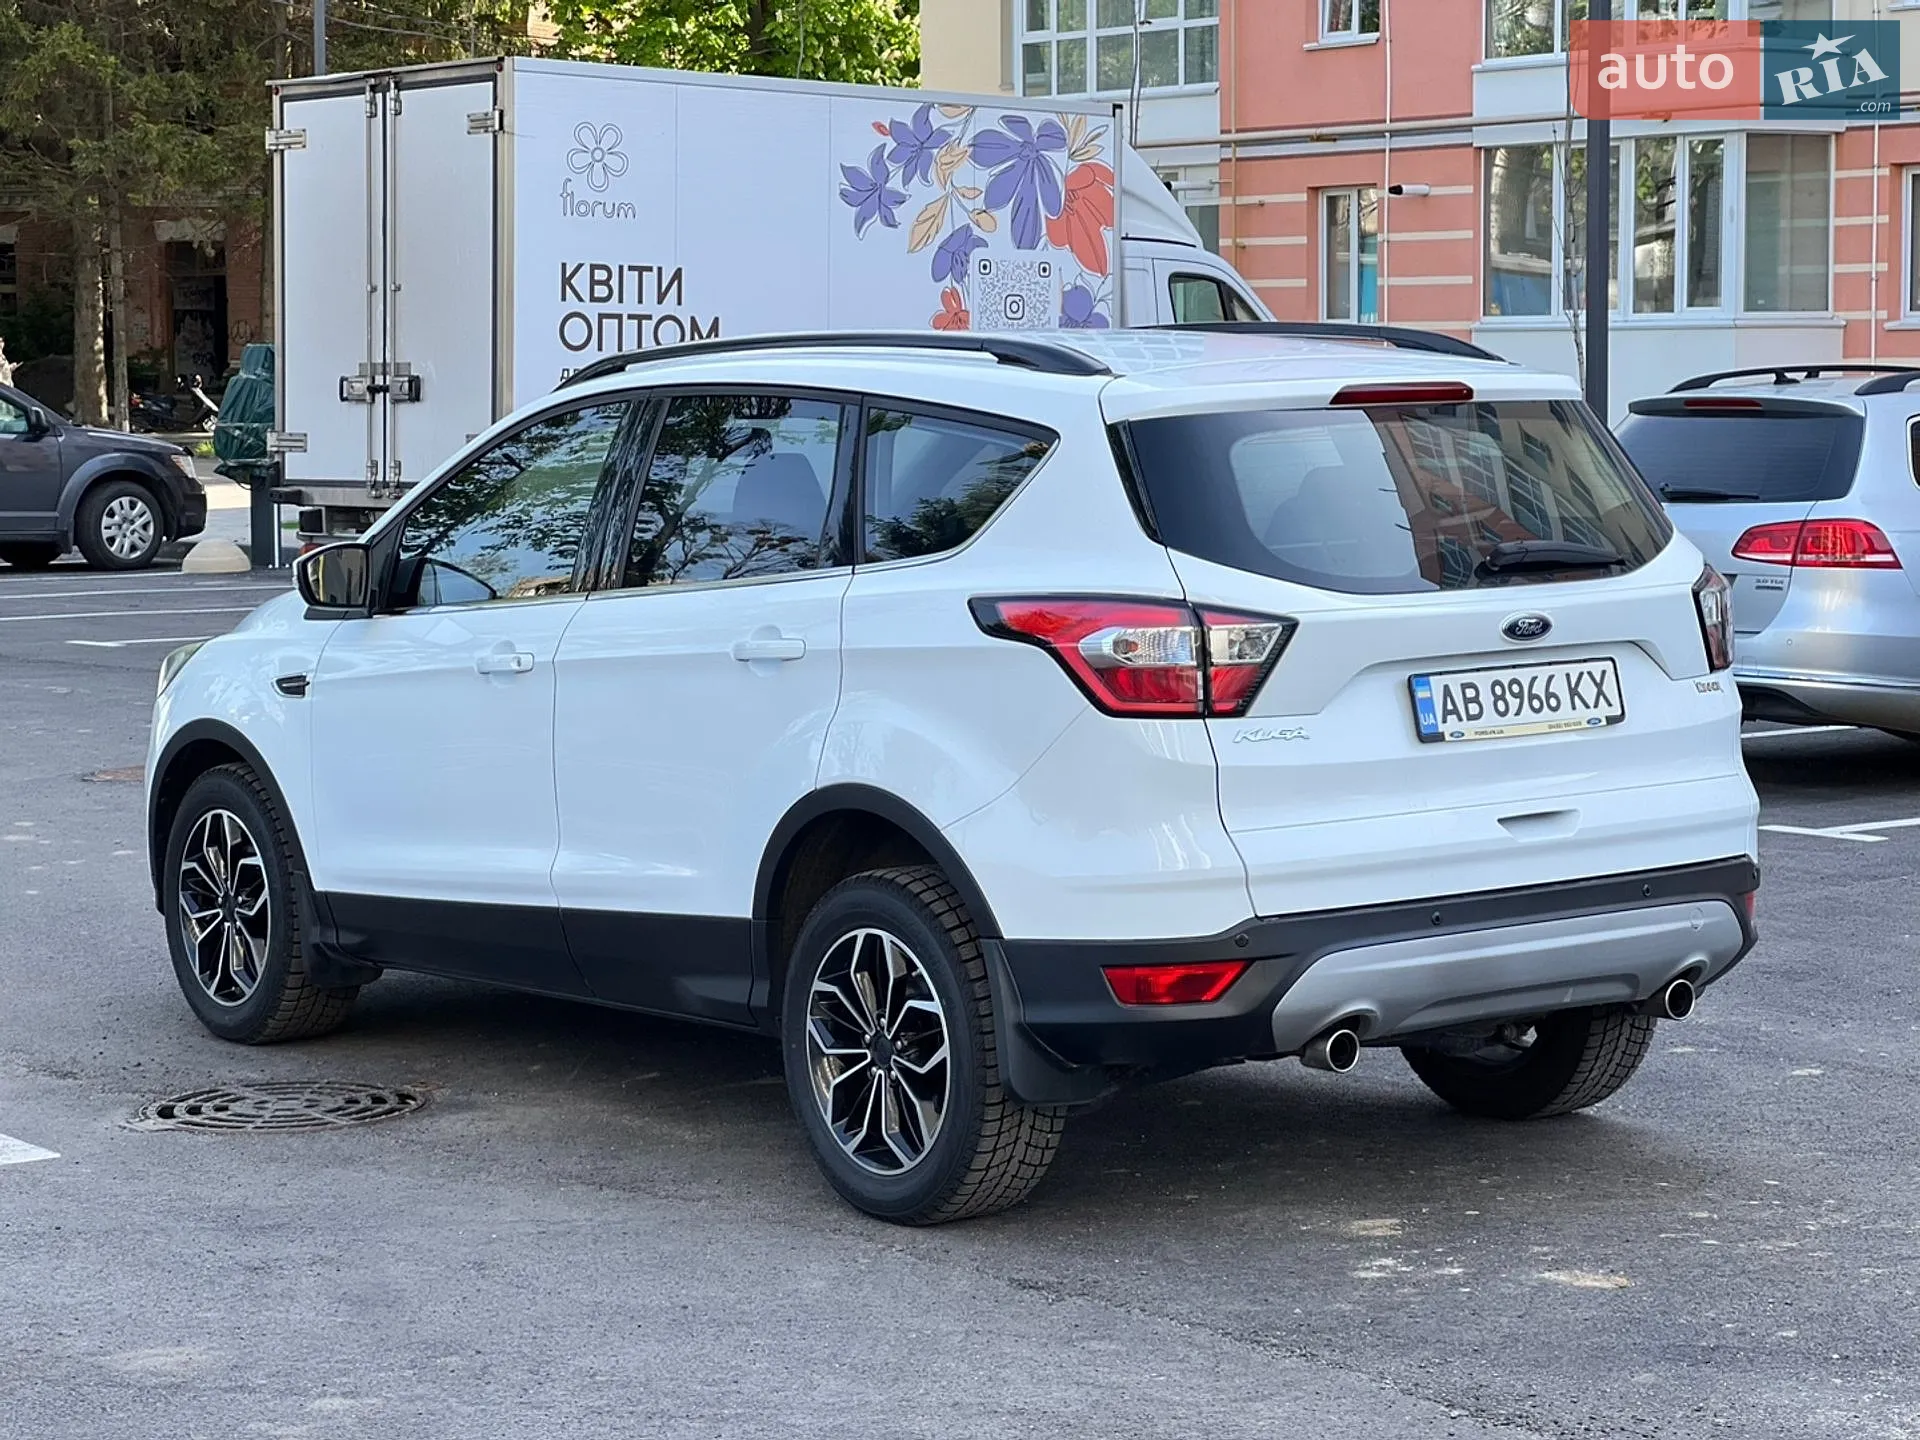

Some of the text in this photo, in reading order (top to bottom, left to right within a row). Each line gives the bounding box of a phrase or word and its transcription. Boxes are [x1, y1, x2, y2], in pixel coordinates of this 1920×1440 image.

[559, 177, 637, 219] florum
[560, 261, 683, 306] КВІТИ
[1513, 617, 1545, 636] Ford
[1441, 669, 1613, 724] AB 8966 KX
[1233, 726, 1310, 743] KUGA
[1421, 713, 1436, 727] UA
